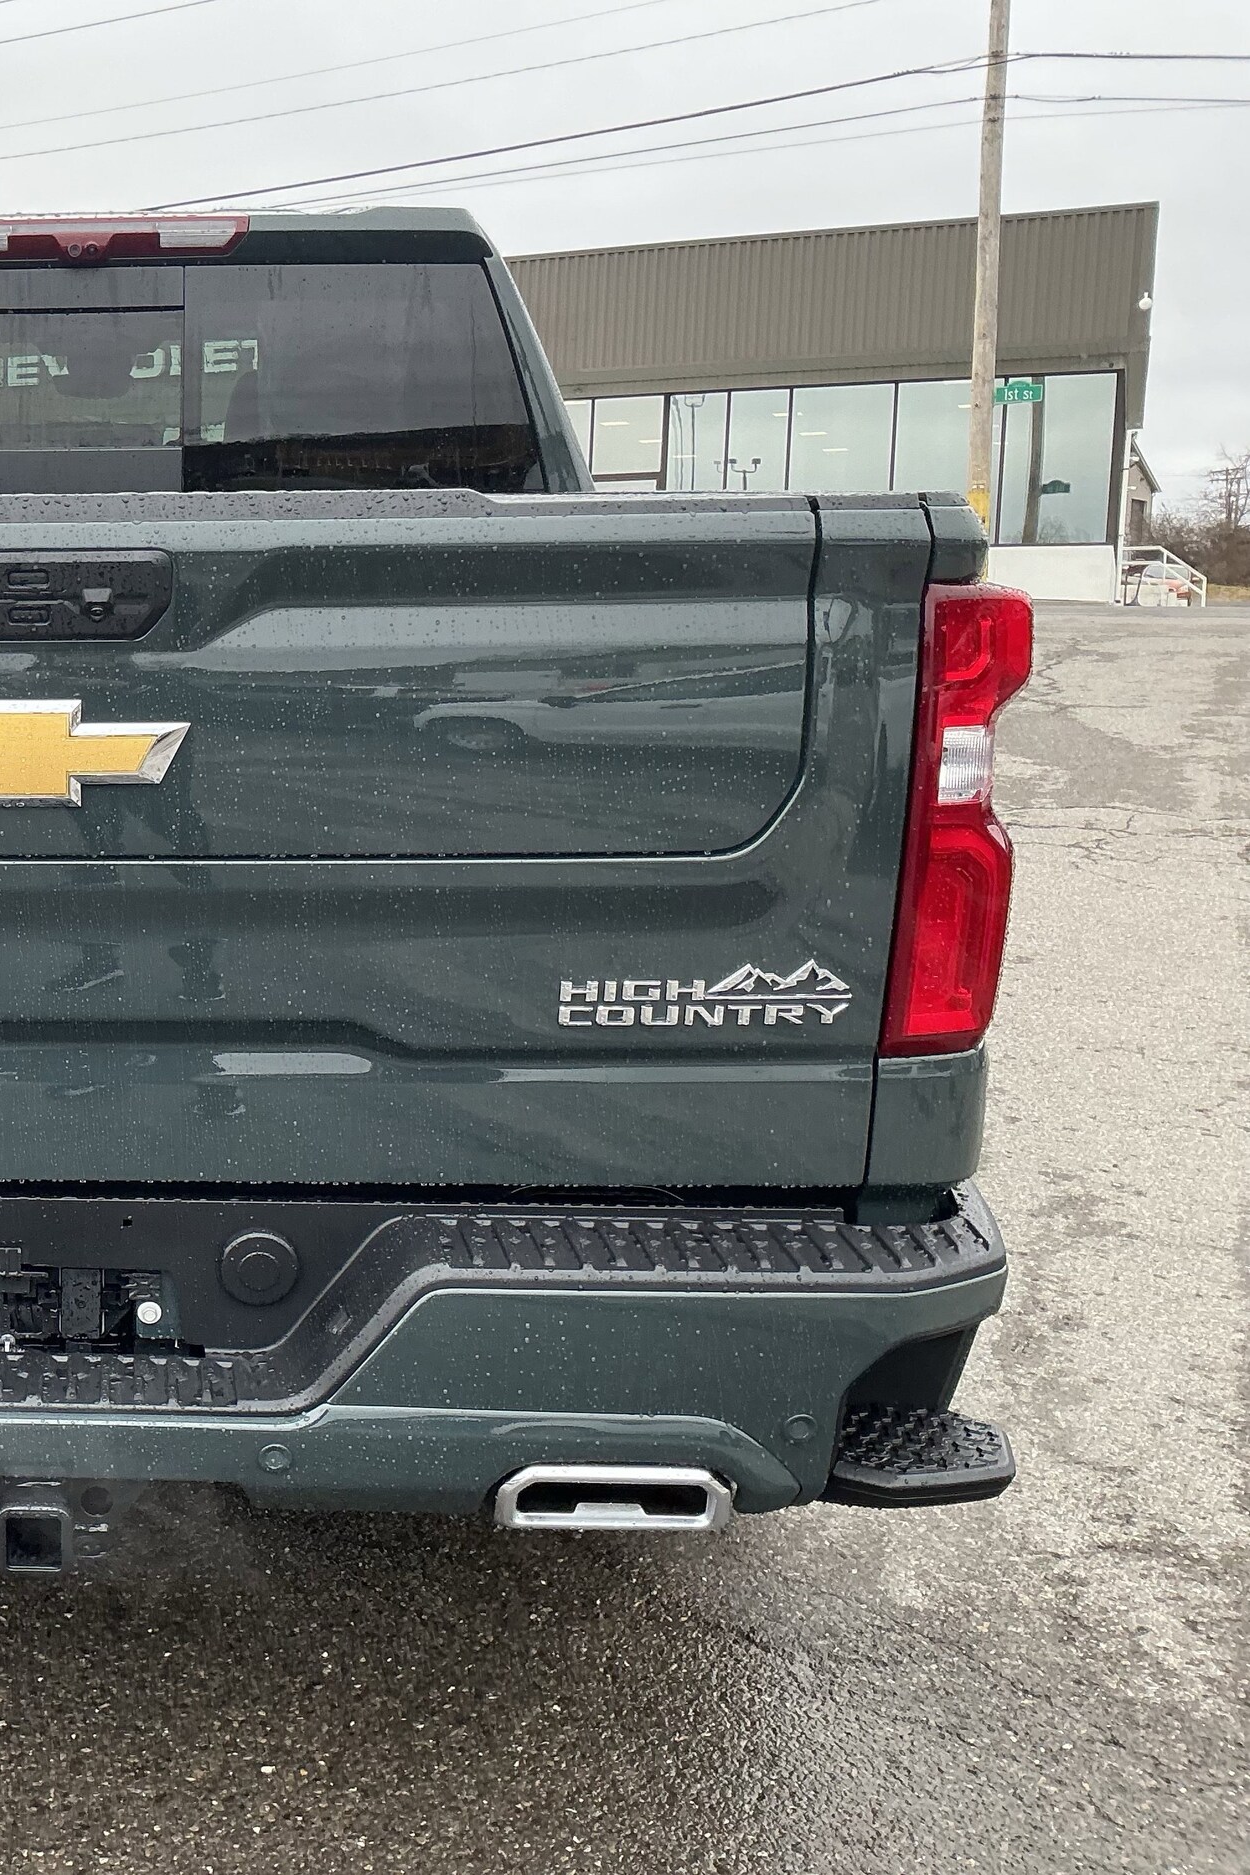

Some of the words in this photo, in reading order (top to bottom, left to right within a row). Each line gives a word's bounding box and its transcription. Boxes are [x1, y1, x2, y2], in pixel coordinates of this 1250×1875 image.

[1004, 388, 1019, 401] 1st
[1023, 390, 1033, 400] St
[559, 979, 706, 1002] HIGH
[558, 1003, 850, 1028] COUNTRY
